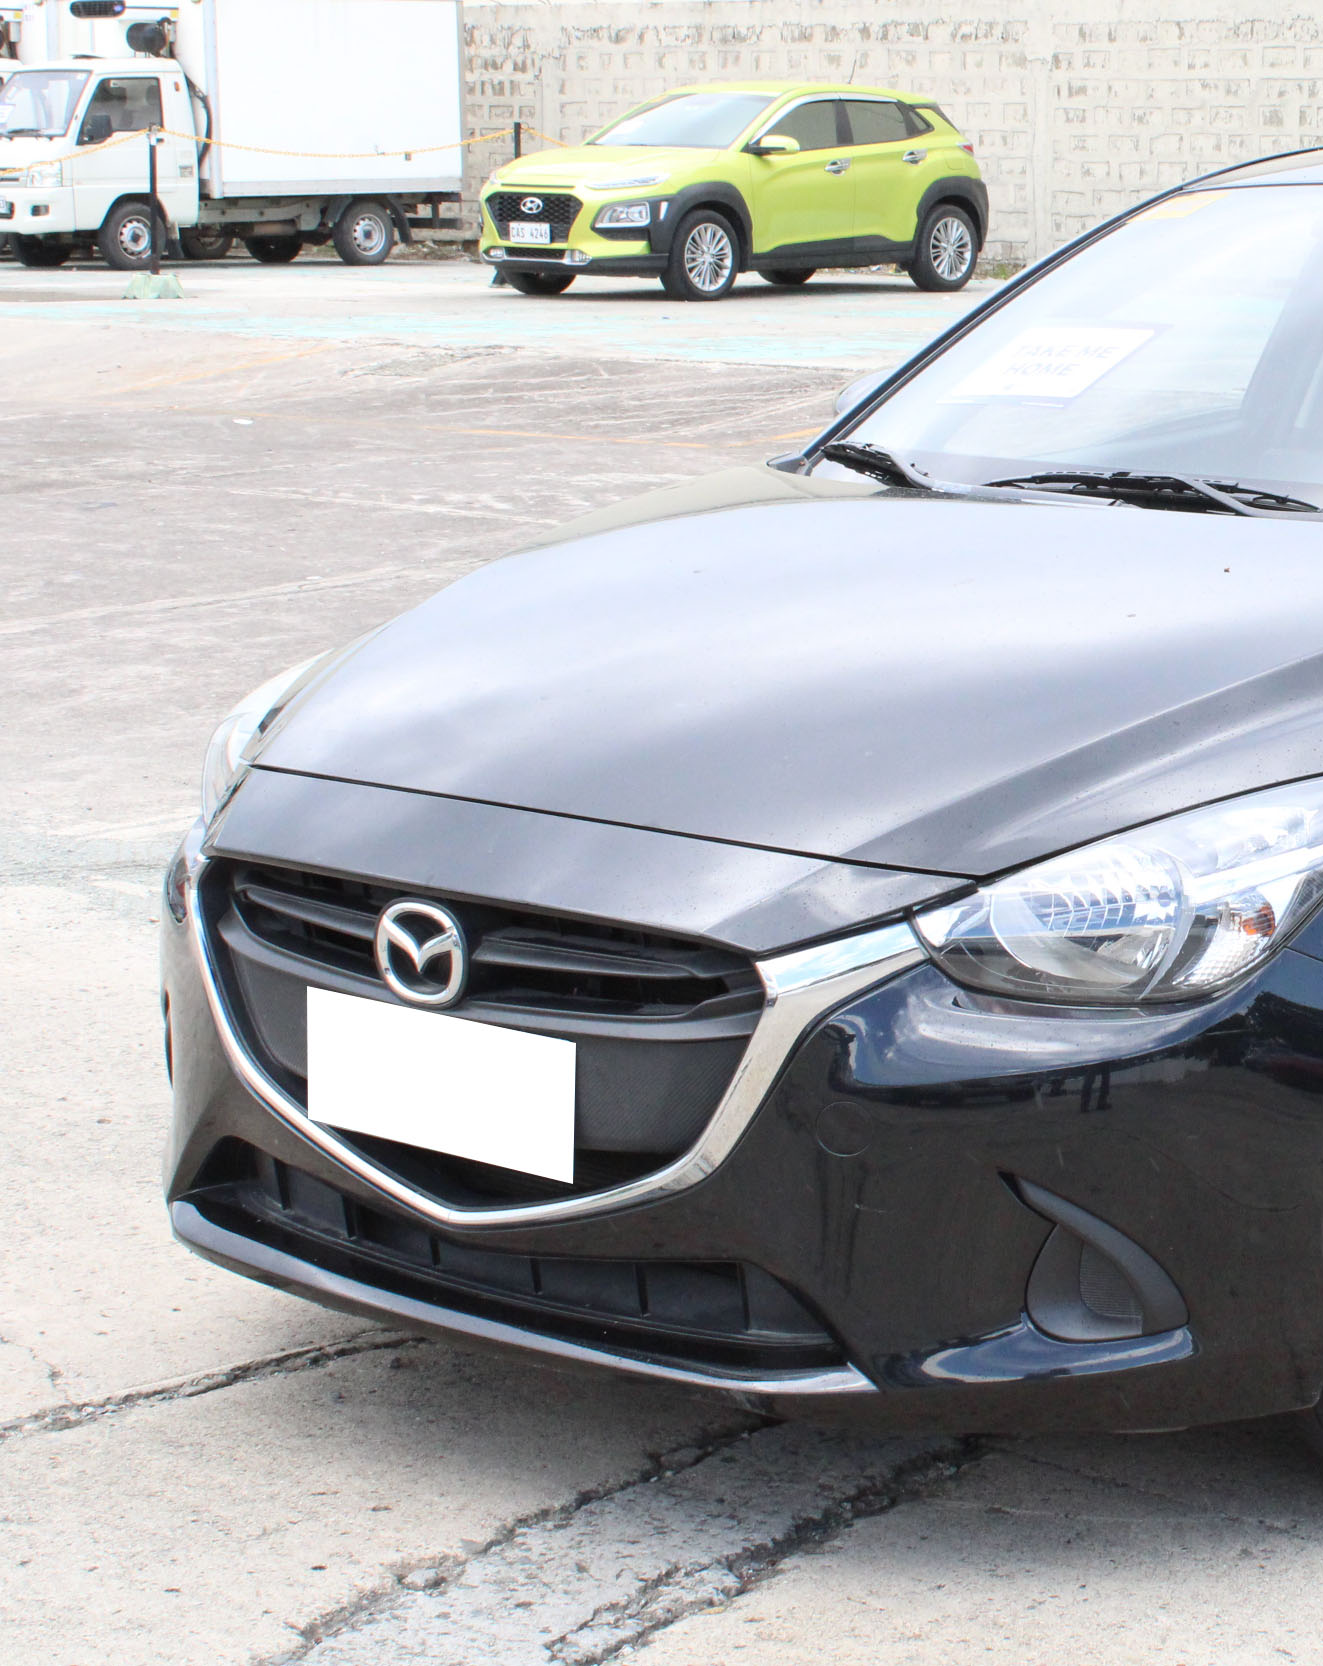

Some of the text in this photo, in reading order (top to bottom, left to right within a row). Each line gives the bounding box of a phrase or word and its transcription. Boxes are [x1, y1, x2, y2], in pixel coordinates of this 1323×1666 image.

[1012, 344, 1120, 359] TAKE ME
[1003, 362, 1080, 376] HOME
